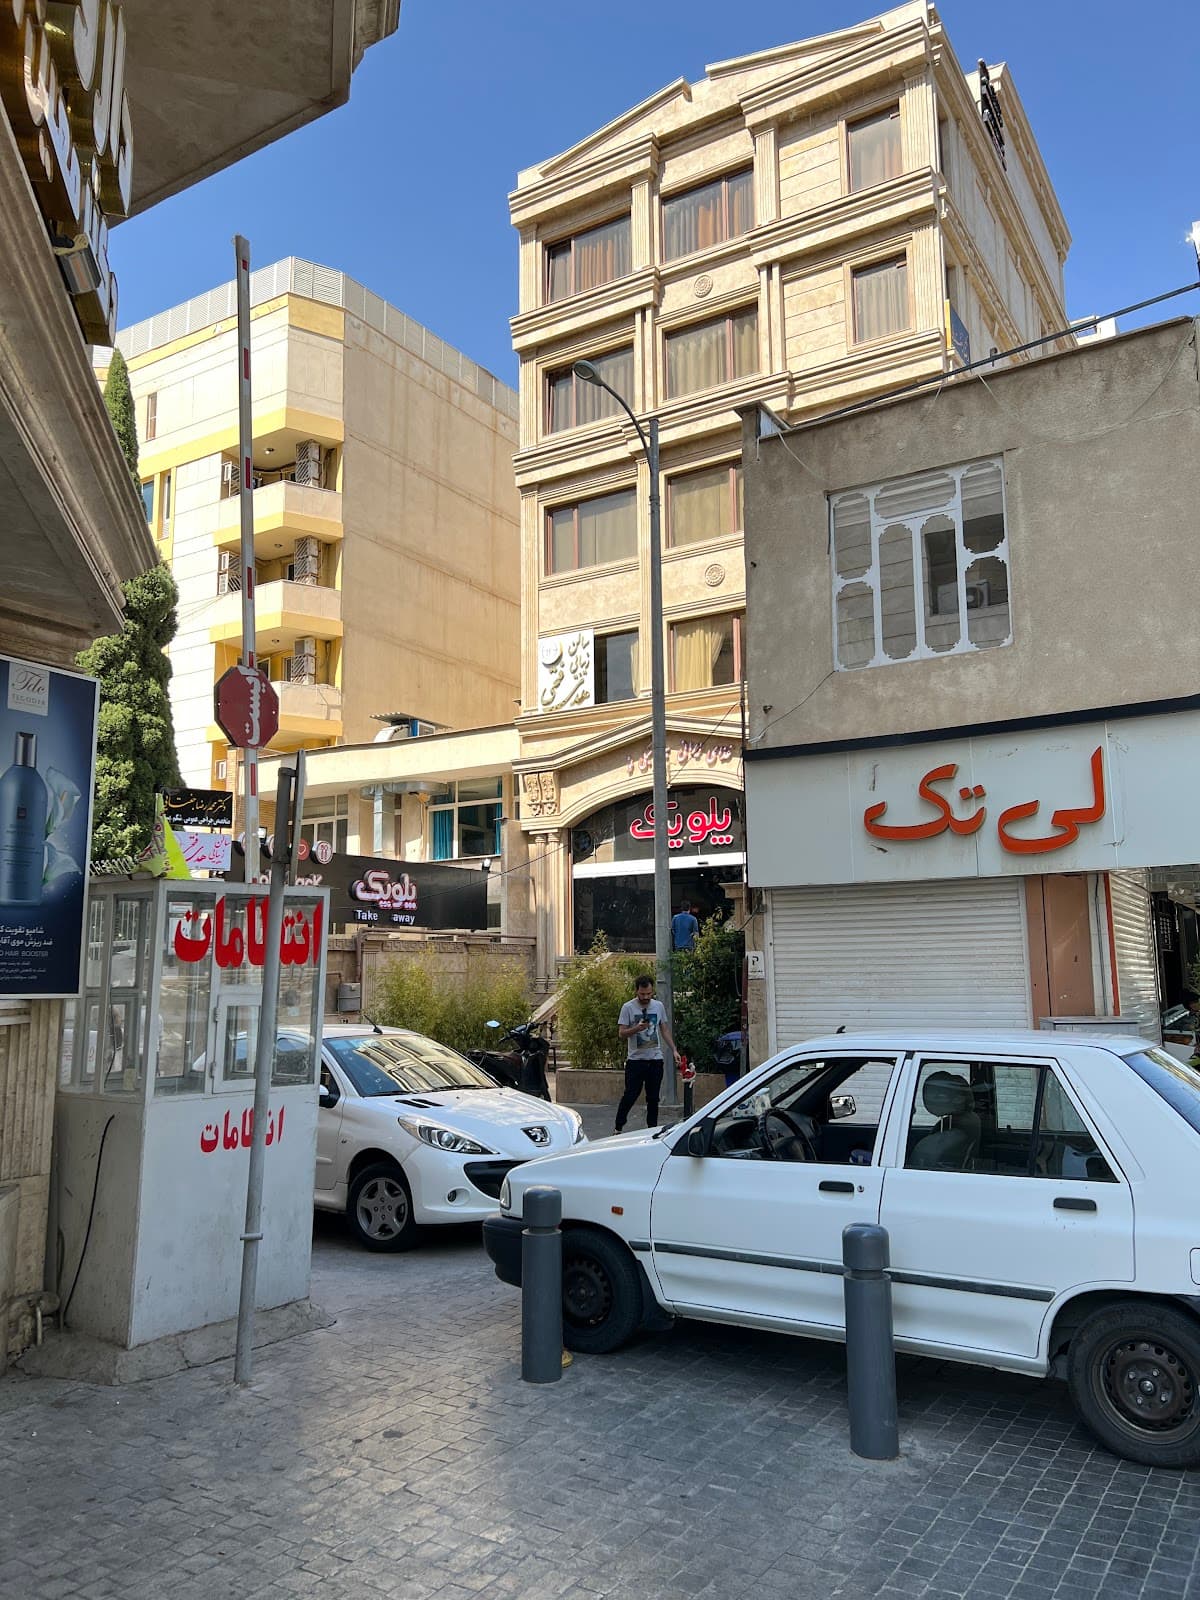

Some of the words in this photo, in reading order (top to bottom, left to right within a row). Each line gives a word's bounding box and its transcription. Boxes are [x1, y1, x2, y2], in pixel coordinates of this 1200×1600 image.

[237, 665, 266, 745] ایست
[864, 763, 987, 841] تک
[998, 745, 1106, 855] لی
[356, 909, 378, 921] Take
[392, 912, 416, 926] away
